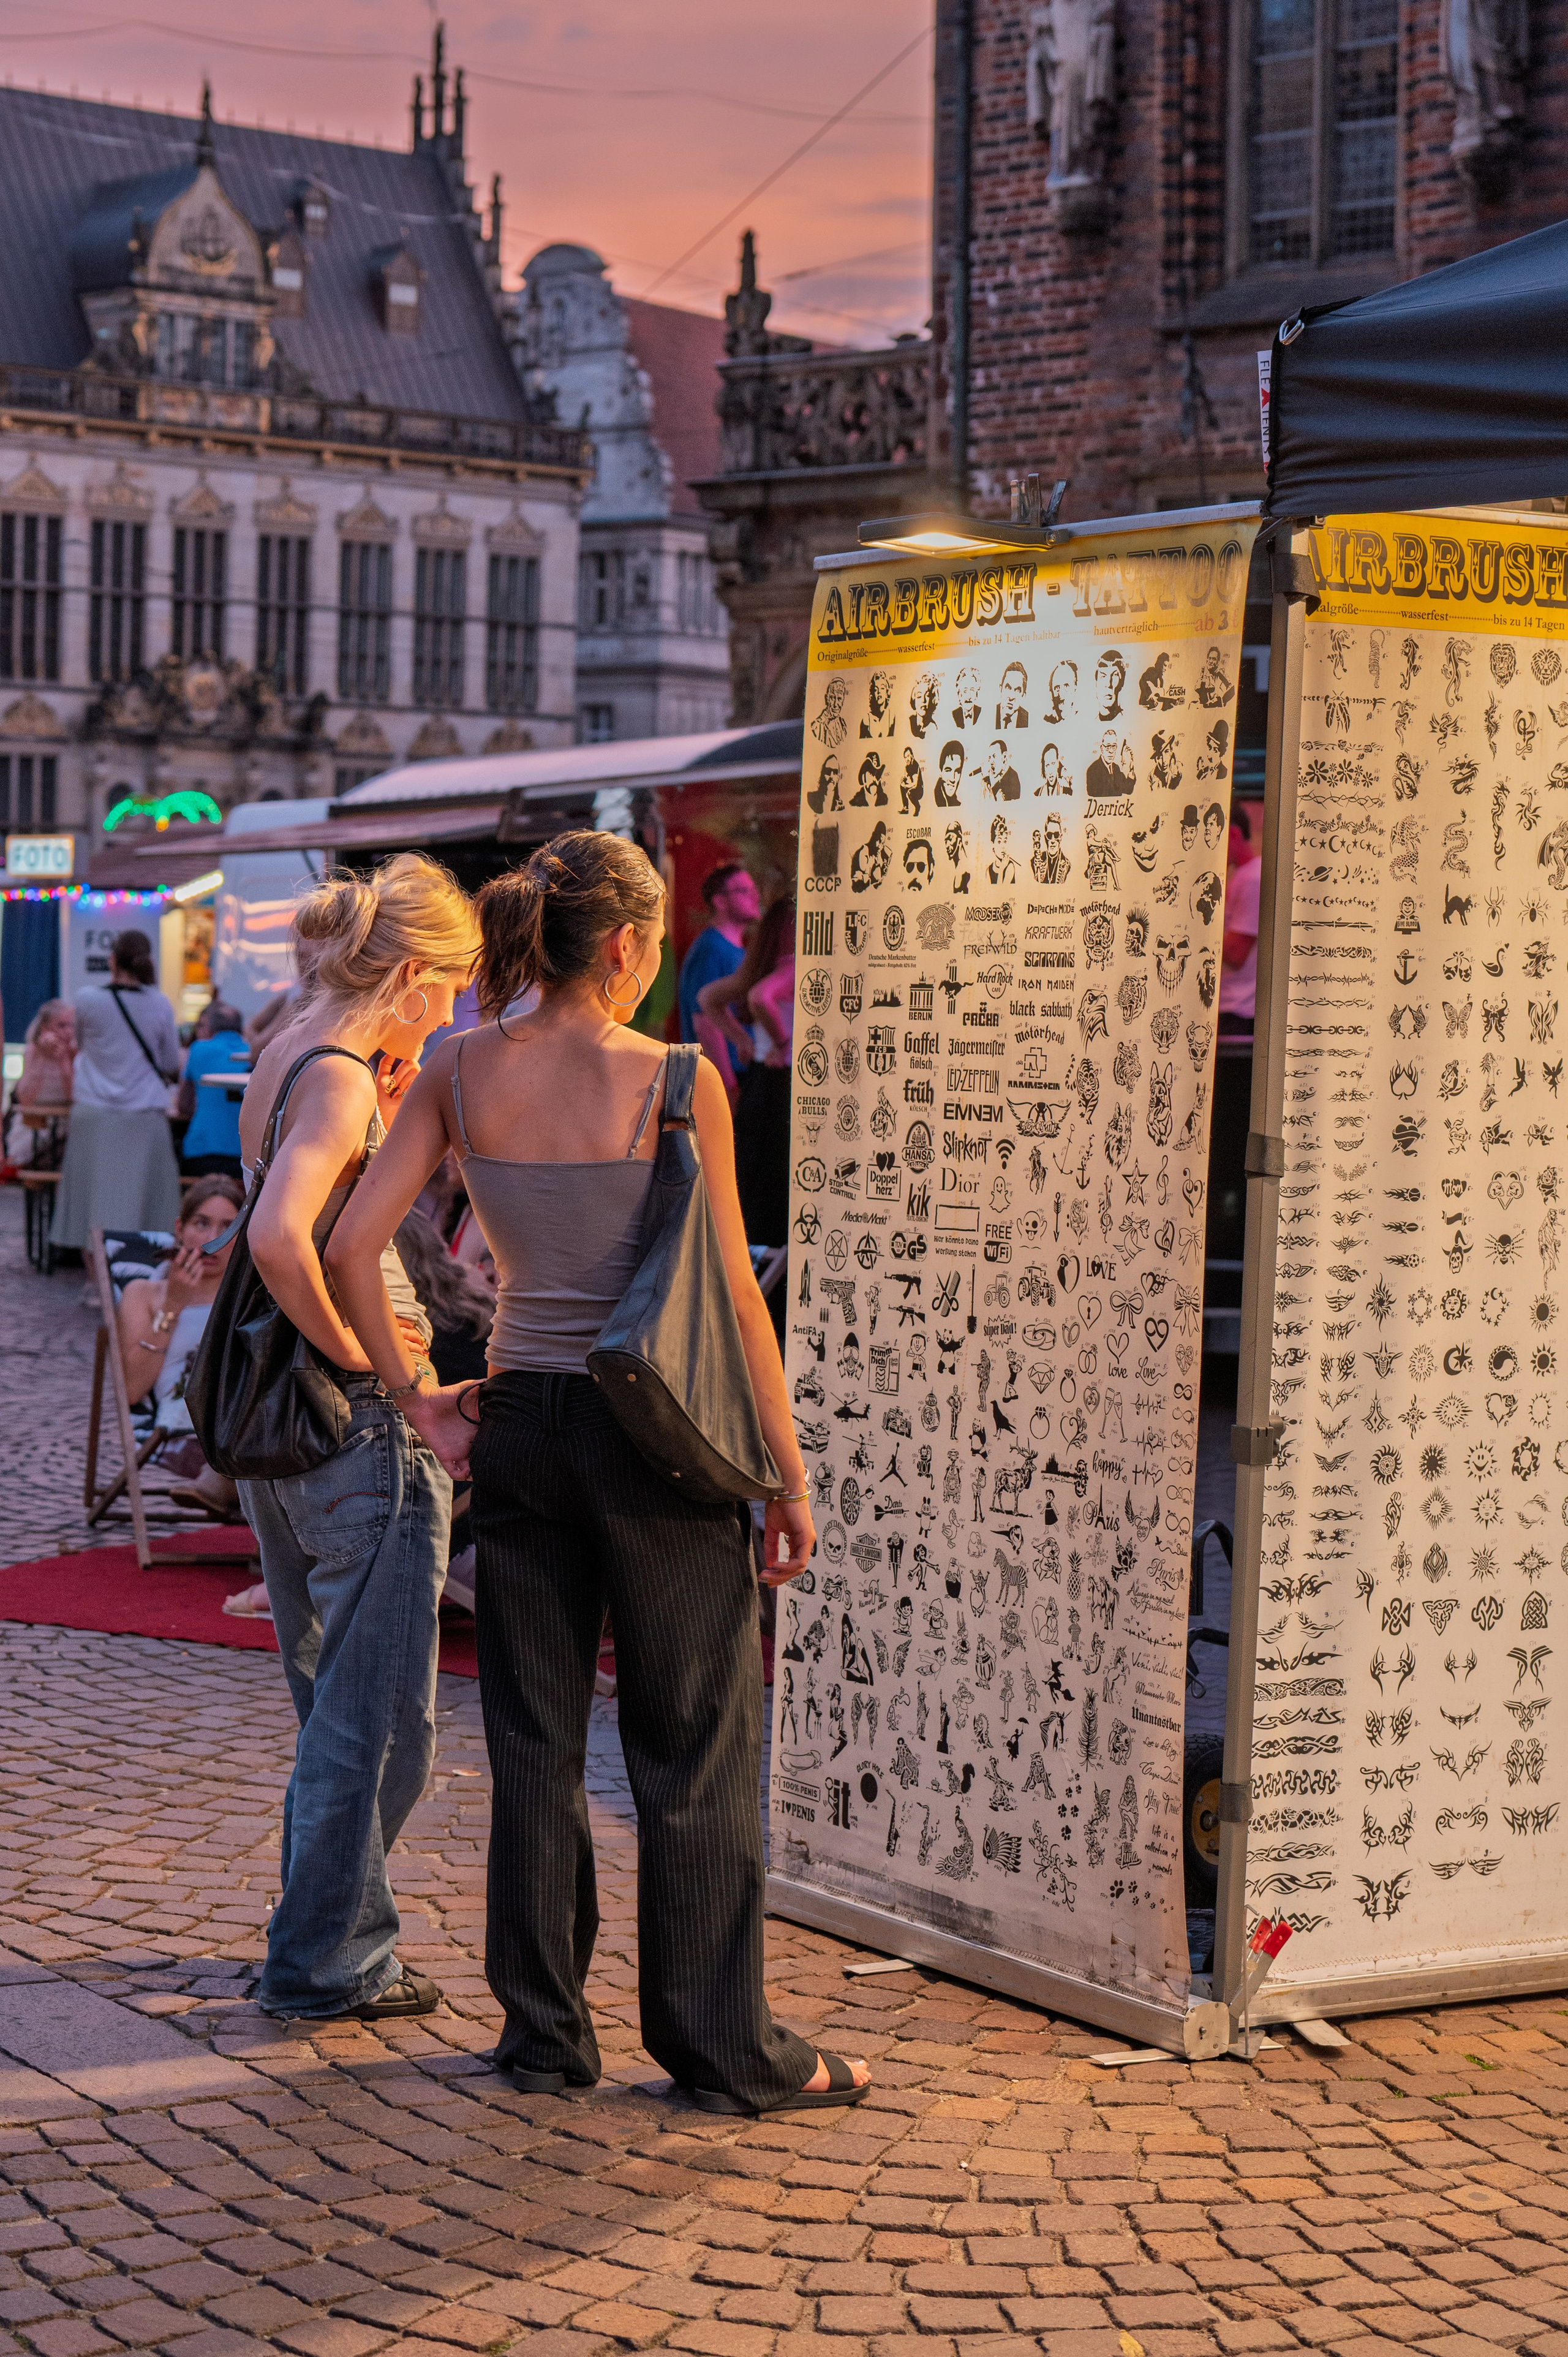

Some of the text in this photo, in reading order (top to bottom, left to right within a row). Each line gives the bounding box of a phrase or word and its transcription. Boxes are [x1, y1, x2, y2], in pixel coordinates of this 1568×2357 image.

[817, 562, 1038, 643] AIRBRUSH
[1071, 539, 1243, 618] TATTOO
[1401, 608, 1449, 622] wasserfest
[1493, 614, 1507, 626] bis
[1510, 618, 1521, 627] zu
[1523, 616, 1533, 628] 14
[1536, 618, 1566, 632] Tagen
[817, 646, 869, 664] Originalgröße
[897, 641, 935, 654] wasserfest
[968, 634, 981, 646] bis
[982, 635, 992, 646] zu
[993, 633, 1003, 644] 14
[1005, 630, 1030, 644] Tagen
[1033, 629, 1061, 641] haltbar
[1093, 620, 1159, 638] hautverträglich
[1084, 798, 1134, 819] Derrick
[906, 827, 932, 839] ESCOBAR
[14, 845, 67, 868] FOTO
[805, 877, 842, 892] CCCP
[1027, 902, 1075, 915] DEPECHE MODE
[802, 911, 834, 956] Bild
[1025, 926, 1074, 940] KRAFTWERK
[1024, 951, 1075, 968] SCORPIONS
[977, 972, 1014, 986] Hard Rock
[1018, 978, 1074, 992] IRON MAIDEN
[822, 988, 831, 1011] LEIPZIG
[843, 998, 859, 1011] CFC
[909, 1012, 933, 1021] BERLIN
[1010, 1000, 1072, 1021] black sabbath
[963, 1012, 1000, 1027] PACHA
[904, 1031, 940, 1057] Gaffel
[948, 1038, 1005, 1059] Jägermeister
[910, 1056, 933, 1071] Kölsch
[797, 1096, 831, 1106] CHICAGO
[799, 1105, 826, 1116] BULLS
[905, 1149, 932, 1161] HANSA
[829, 1178, 843, 1188] STOP
[870, 1170, 898, 1187] Doppel
[940, 1167, 980, 1195] Dior
[829, 1187, 856, 1201] CONTROL!
[875, 1183, 892, 1196] herz
[841, 1210, 888, 1225] Media Markt
[986, 1224, 1012, 1239] FREE
[945, 1236, 964, 1244] könnte
[793, 1324, 817, 1336] AntiFA
[983, 1324, 1000, 1337] Super
[870, 1347, 892, 1357] Trimm
[870, 1356, 886, 1366] Dich
[1108, 1362, 1128, 1379] love
[1093, 1450, 1123, 1481] happy
[885, 1494, 903, 1508] Darts
[1136, 1520, 1148, 1532] love
[821, 1519, 848, 1550] HARLEY DAVIDSON
[858, 1537, 875, 1546] MOTOR
[851, 1546, 881, 1560] HARLEY-DAVIDSON
[857, 1559, 873, 1571] CYCLES
[1147, 1558, 1177, 1583] Paris
[1127, 1581, 1149, 1599] Always
[1141, 1598, 1164, 1614] Forever
[1132, 1706, 1182, 1733] Unantastbar
[856, 1760, 884, 1780] GLORY HOLE
[1139, 1762, 1179, 1785] Carpe Diem
[782, 1780, 818, 1798] 100% PENIS
[1143, 1788, 1161, 1815] Stay
[791, 1803, 815, 1823] PENIS
[1152, 1824, 1161, 1838] life
[1163, 1829, 1169, 1840] is
[1144, 1841, 1168, 1857] collection
[1171, 1848, 1178, 1861] of
[1152, 1863, 1172, 1876] moments
